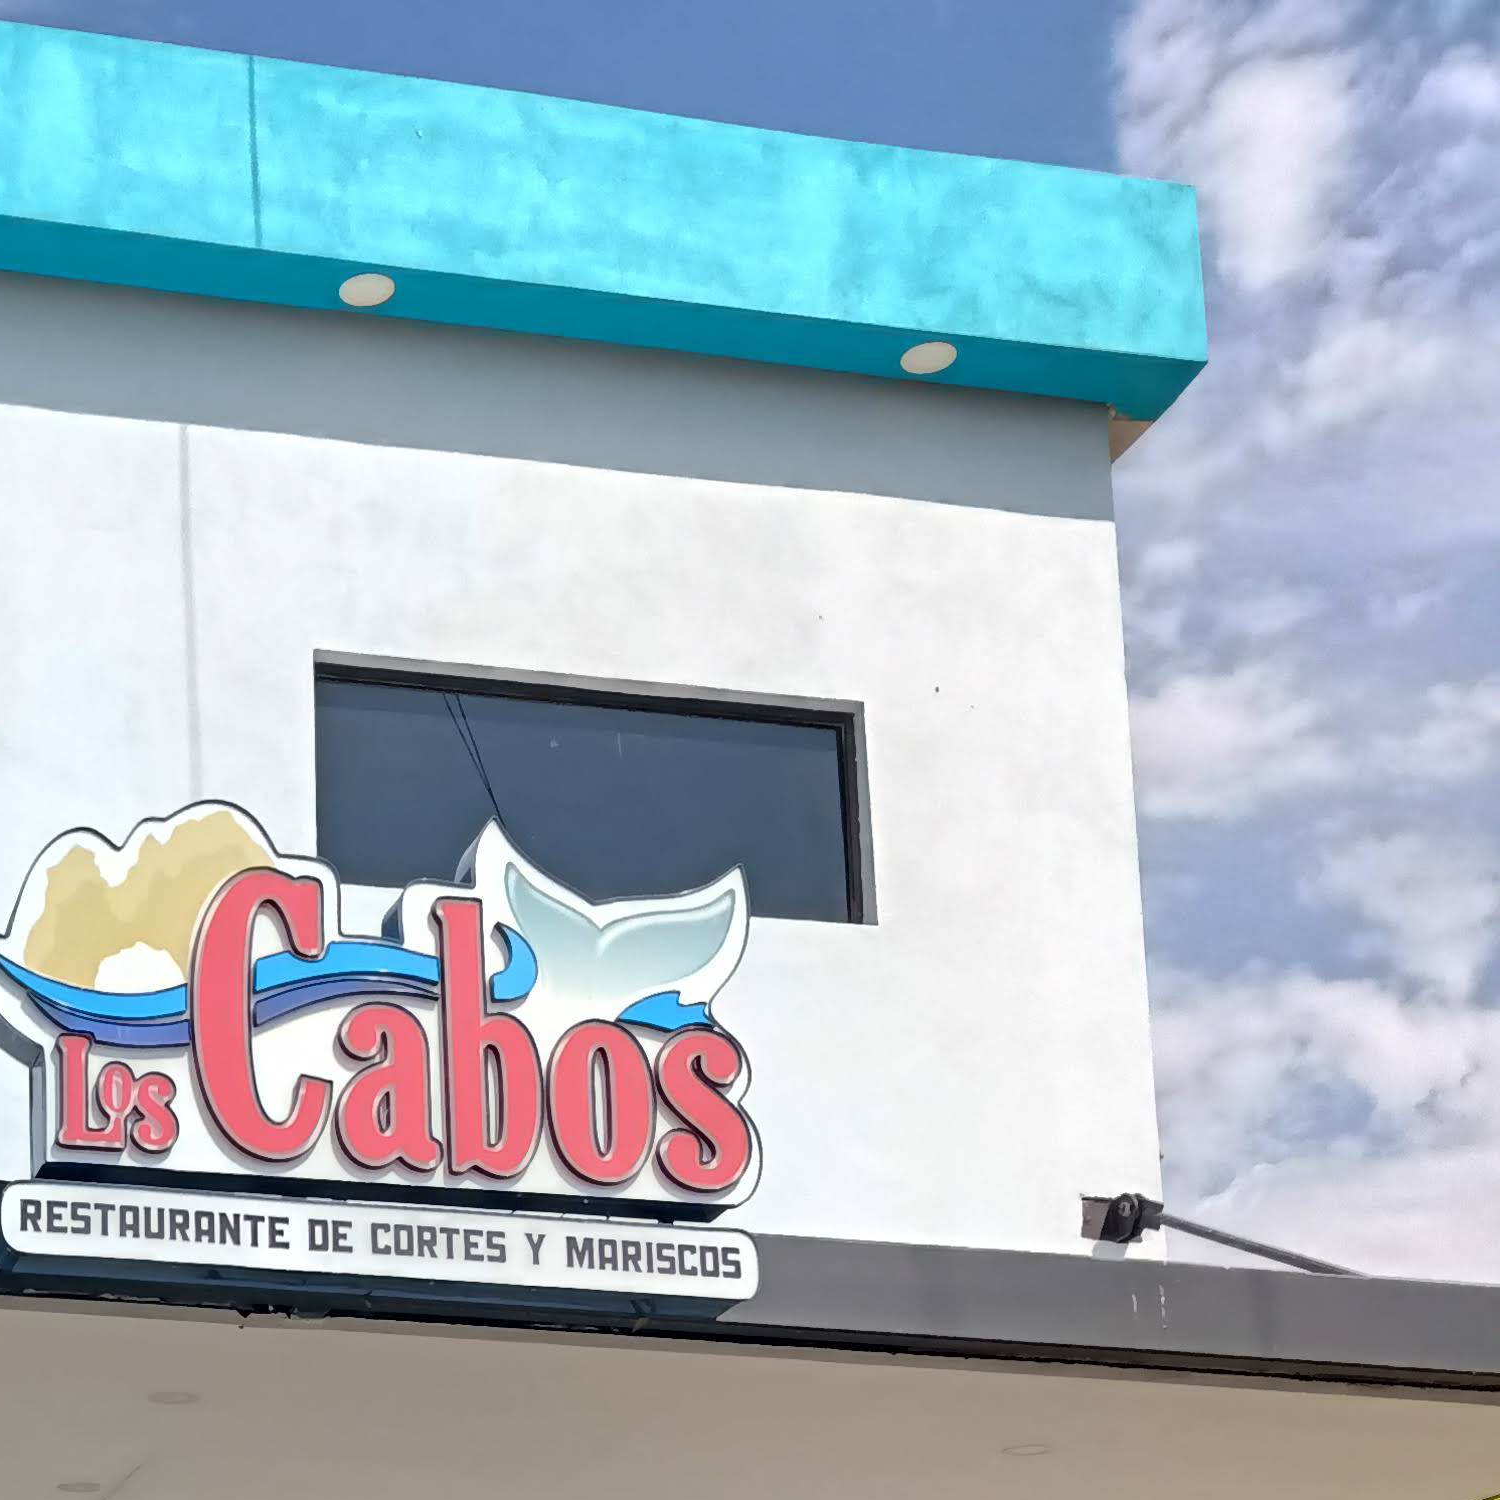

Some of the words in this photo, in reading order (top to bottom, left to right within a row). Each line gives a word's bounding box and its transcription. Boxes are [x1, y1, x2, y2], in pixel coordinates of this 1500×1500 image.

[56, 1034, 180, 1152] Los
[189, 866, 752, 1196] Cabos
[20, 1200, 290, 1250] RESTAURANTE
[308, 1218, 354, 1253] DE
[370, 1222, 507, 1263] CORTES
[525, 1232, 545, 1265] Y
[565, 1236, 743, 1280] MARISCOS
